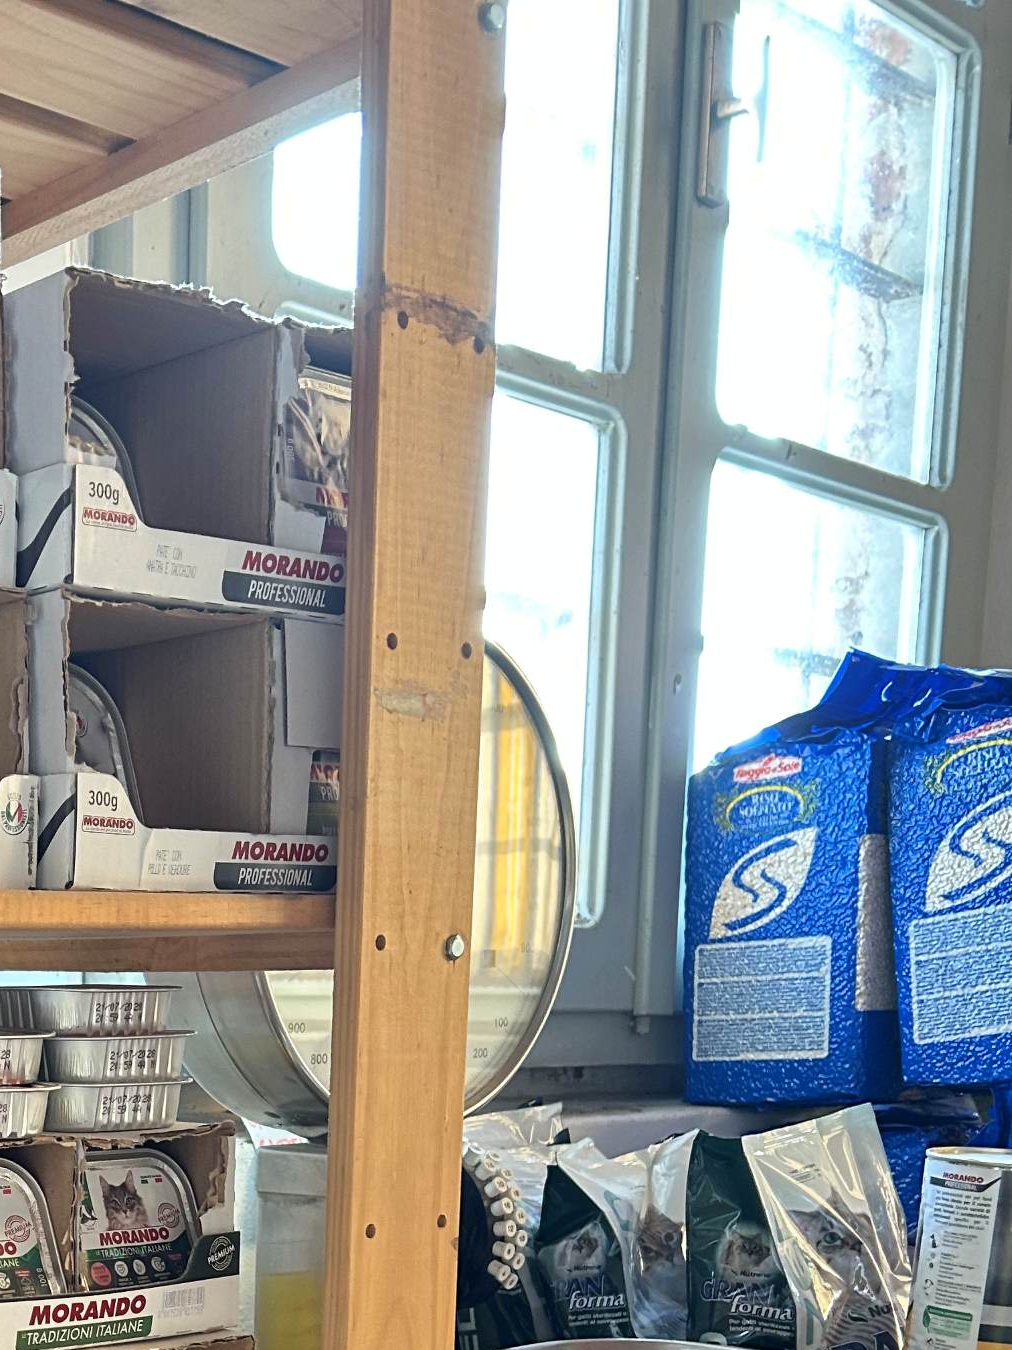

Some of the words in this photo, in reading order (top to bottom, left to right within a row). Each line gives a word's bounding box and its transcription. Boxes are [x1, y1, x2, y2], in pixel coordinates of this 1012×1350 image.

[88, 482, 120, 505] 300g
[83, 508, 135, 526] MORANDO
[241, 550, 345, 584] MORANDO
[247, 579, 326, 608] PROFESSIONAL
[88, 790, 118, 812] 300g
[83, 816, 134, 830] MORANDO
[231, 840, 329, 862] MORANDO
[238, 867, 313, 887] PROFESSIONAL
[288, 1022, 306, 1034] 900
[494, 1017, 508, 1028] 100
[310, 1053, 328, 1065] 800
[473, 1047, 488, 1059] 200
[943, 1171, 984, 1184] MORANDO
[99, 1226, 170, 1246] MORANDO
[207, 1244, 236, 1265] PREMIUM
[29, 1294, 147, 1326] MORANDO
[569, 1291, 624, 1310] forma
[730, 1295, 793, 1321] forma
[26, 1324, 92, 1346] TRADIZIONI
[95, 1318, 144, 1338] ITALIANE
